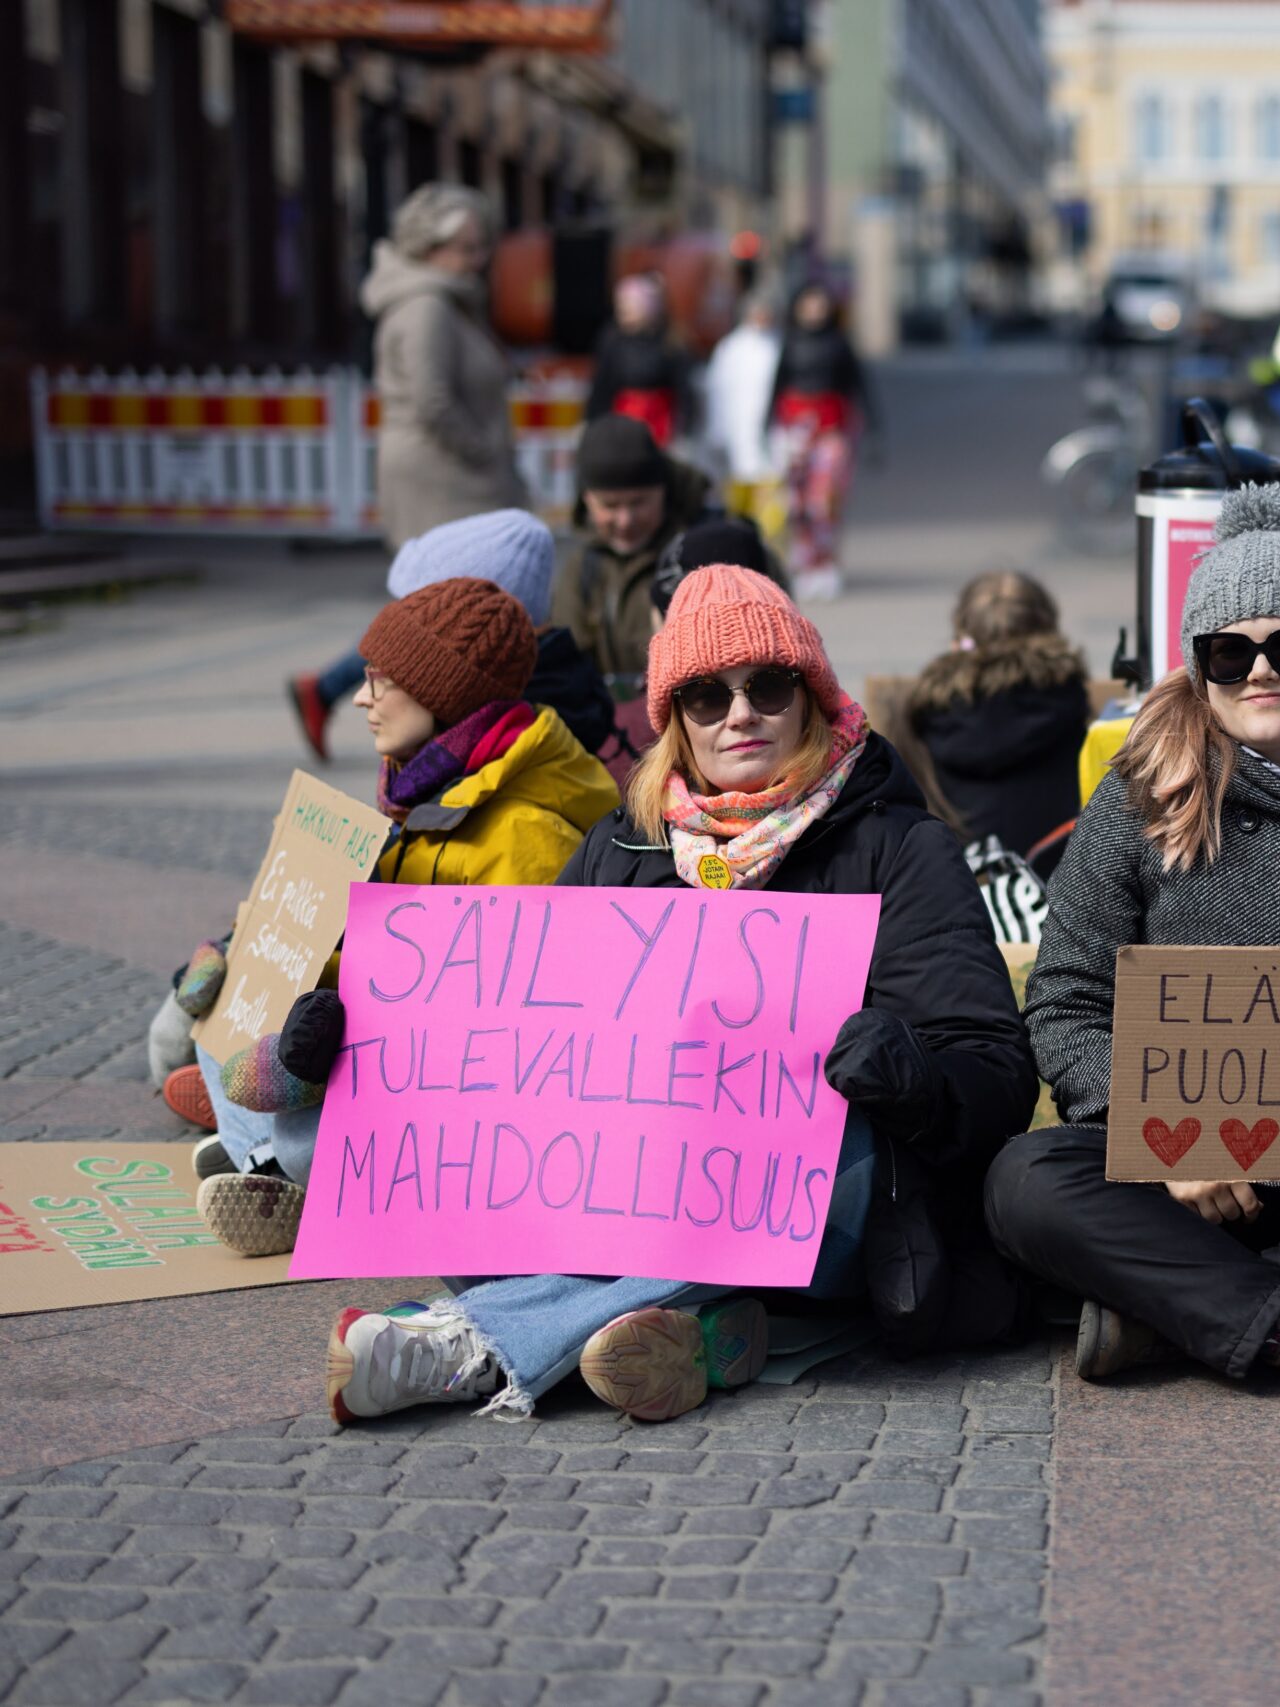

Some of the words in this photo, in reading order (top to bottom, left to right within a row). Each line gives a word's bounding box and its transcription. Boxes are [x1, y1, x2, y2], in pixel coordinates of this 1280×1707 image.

[369, 896, 810, 1033] SÄILYISI
[335, 1027, 821, 1119] TULEVALLEKIN
[29, 1195, 166, 1271] SYDÄN
[336, 1120, 828, 1243] MAHDOLLISUUS
